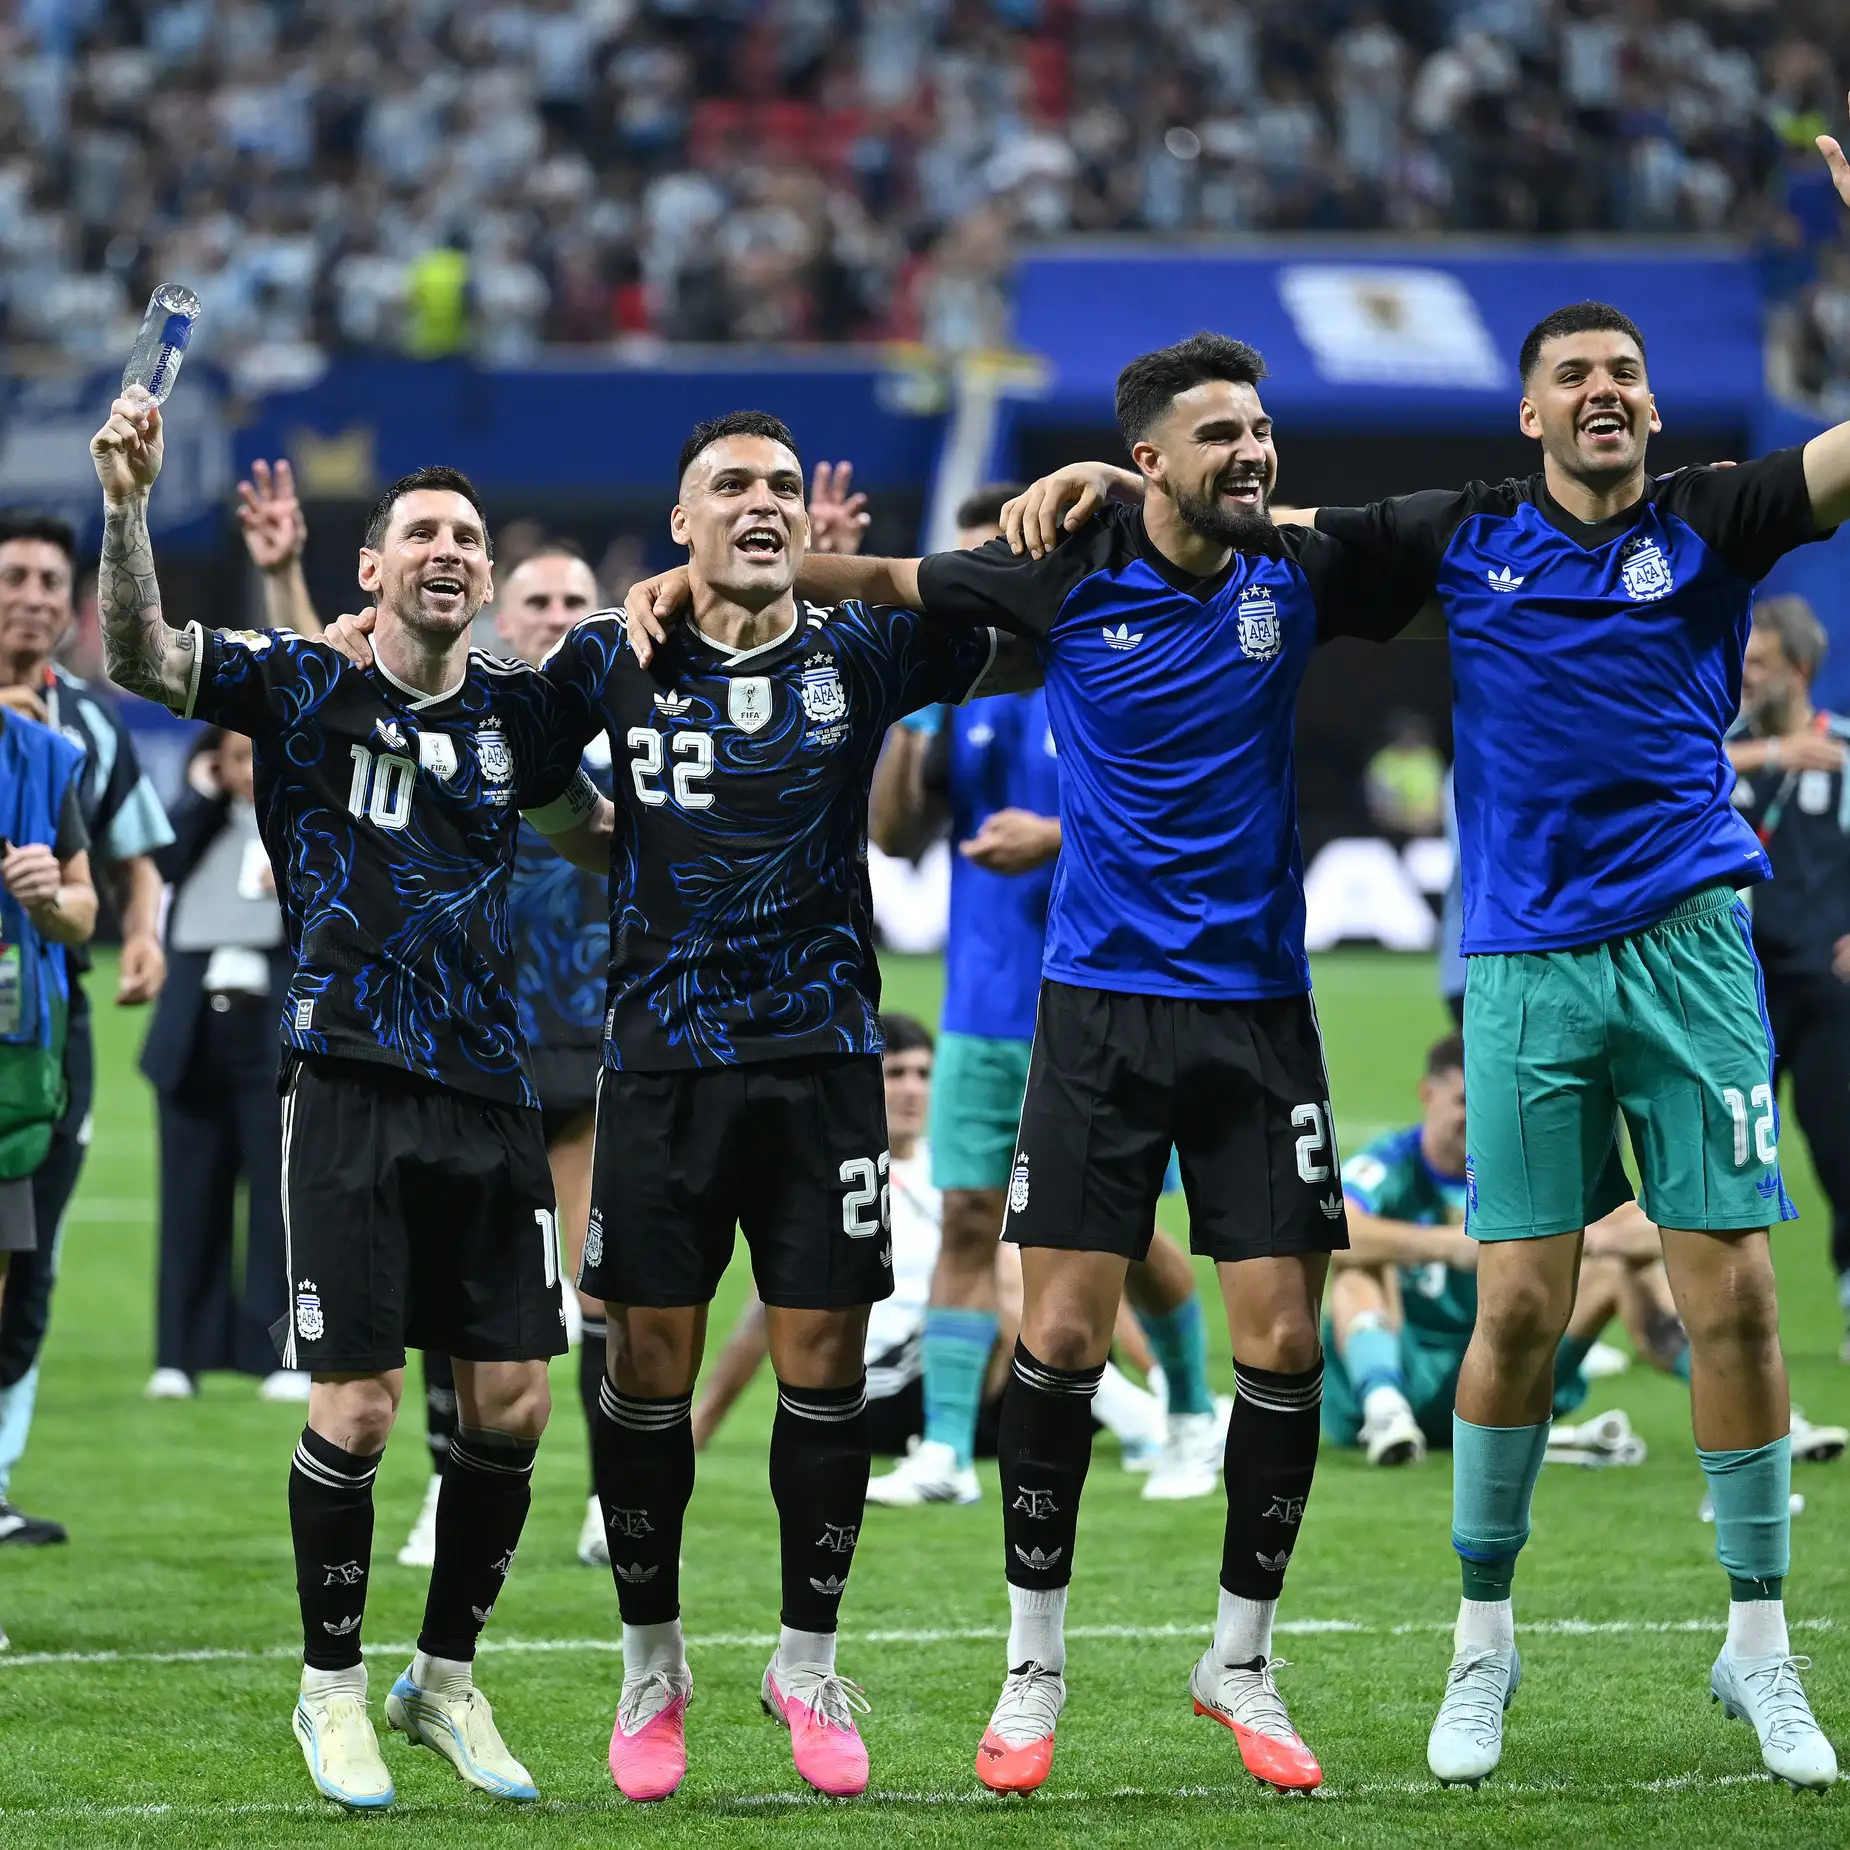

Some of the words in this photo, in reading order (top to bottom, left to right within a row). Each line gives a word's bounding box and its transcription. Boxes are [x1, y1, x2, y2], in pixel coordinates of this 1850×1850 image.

[148, 342, 175, 395] smartwater
[1635, 561, 1660, 584] AFA
[1249, 617, 1272, 643] AFA
[812, 681, 836, 706] AFA
[431, 764, 447, 772] FIFA
[487, 743, 507, 767] AFA
[627, 726, 715, 810] 22
[348, 743, 418, 831] 10
[1722, 1083, 1778, 1168] 12
[1290, 1100, 1339, 1184] 21
[534, 1206, 562, 1289] 1
[1012, 1485, 1059, 1520] AFA
[1262, 1495, 1304, 1525] AFA
[609, 1505, 655, 1539] AFA
[814, 1522, 856, 1553] AFA
[322, 1560, 365, 1586] AFA
[490, 1549, 517, 1576] AF
